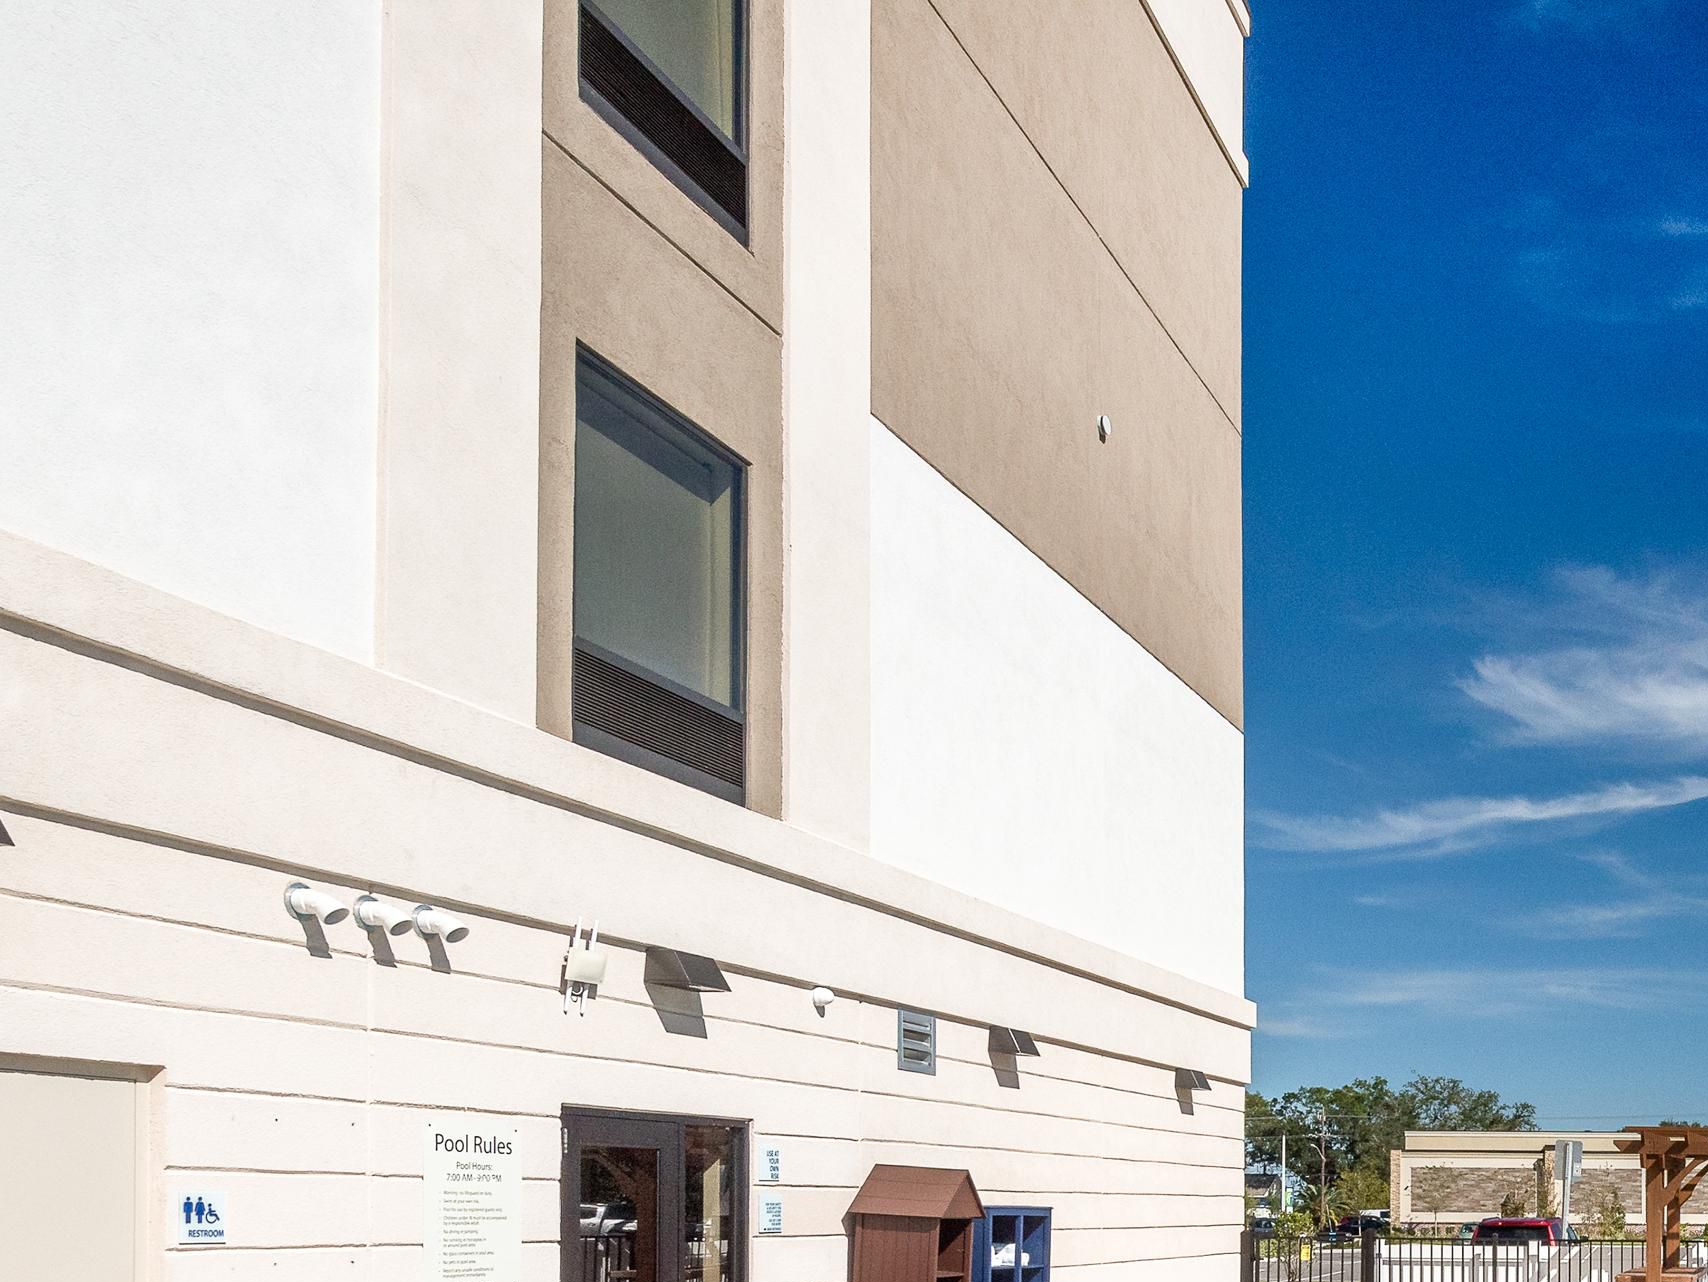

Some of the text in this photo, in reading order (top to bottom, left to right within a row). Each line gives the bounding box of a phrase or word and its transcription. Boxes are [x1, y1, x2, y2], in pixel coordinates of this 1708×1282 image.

[435, 1133, 513, 1155] Pool Rules
[456, 1161, 471, 1170] Pool
[188, 1229, 225, 1238] RESTROOM
